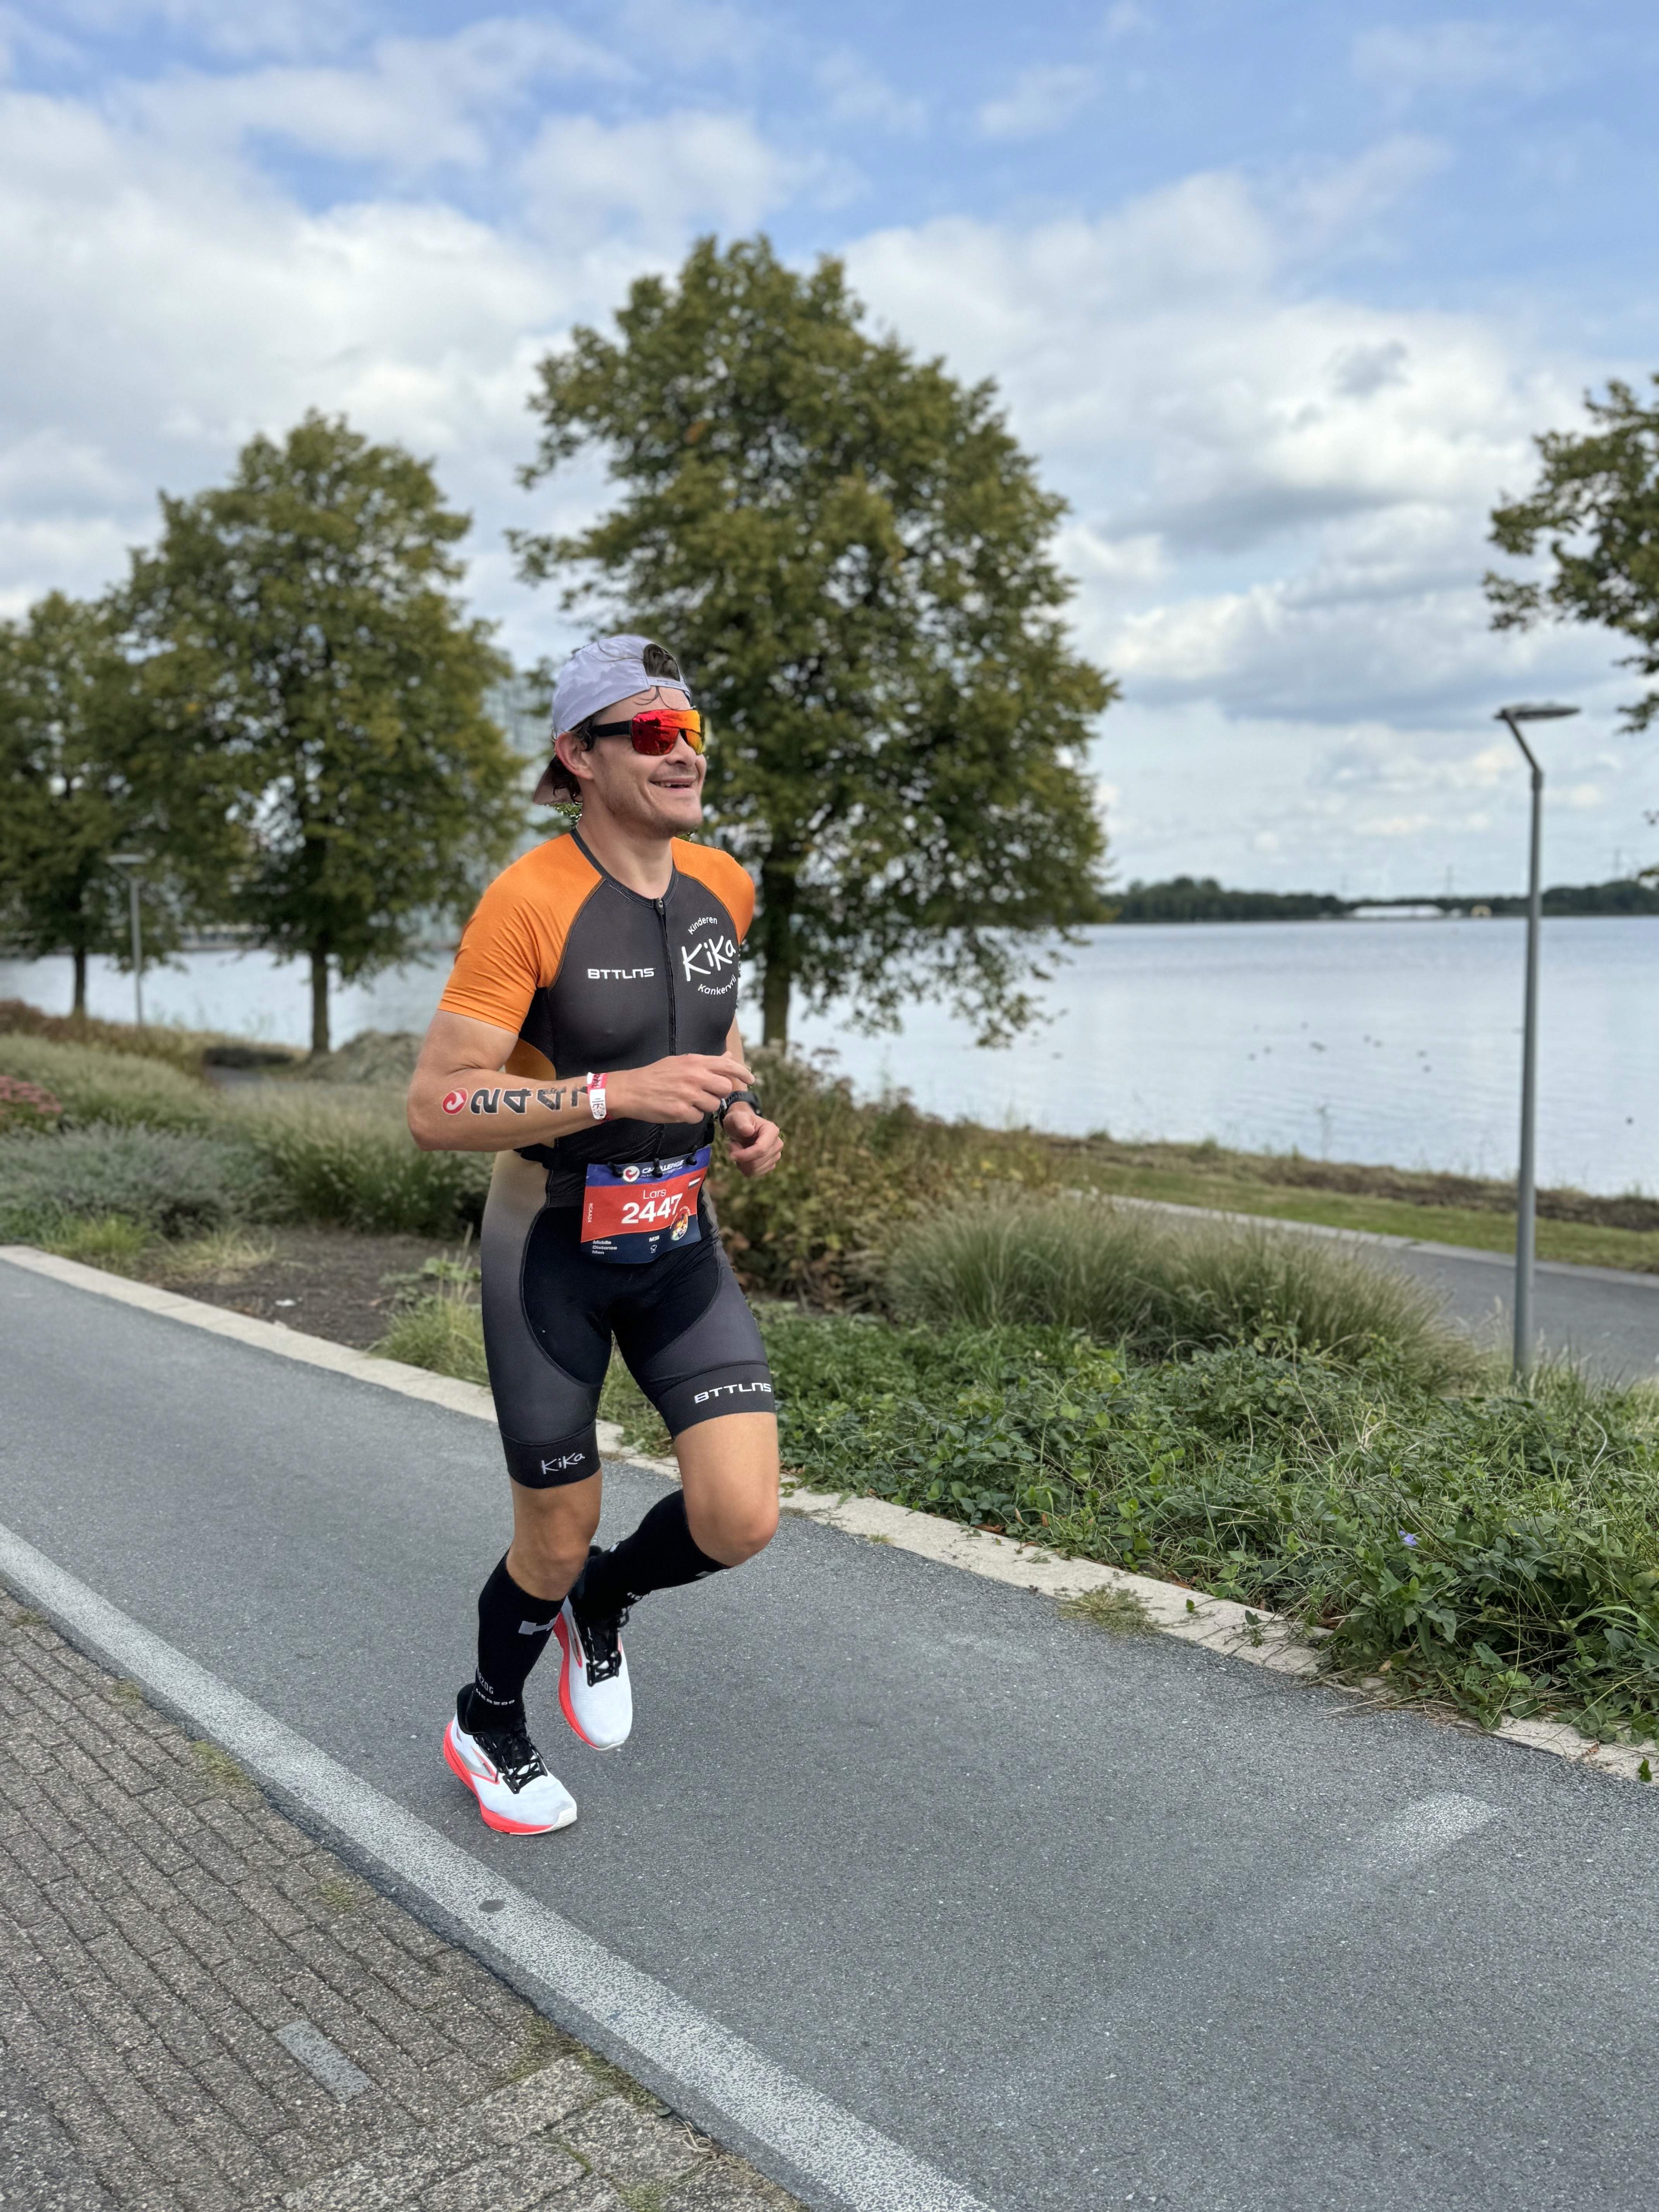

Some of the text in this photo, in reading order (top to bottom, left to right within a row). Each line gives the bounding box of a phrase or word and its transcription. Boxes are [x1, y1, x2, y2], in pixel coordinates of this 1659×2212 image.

[688, 917, 718, 935] Kinderen
[643, 1189, 666, 1199] Lars
[621, 1193, 683, 1224] 2447
